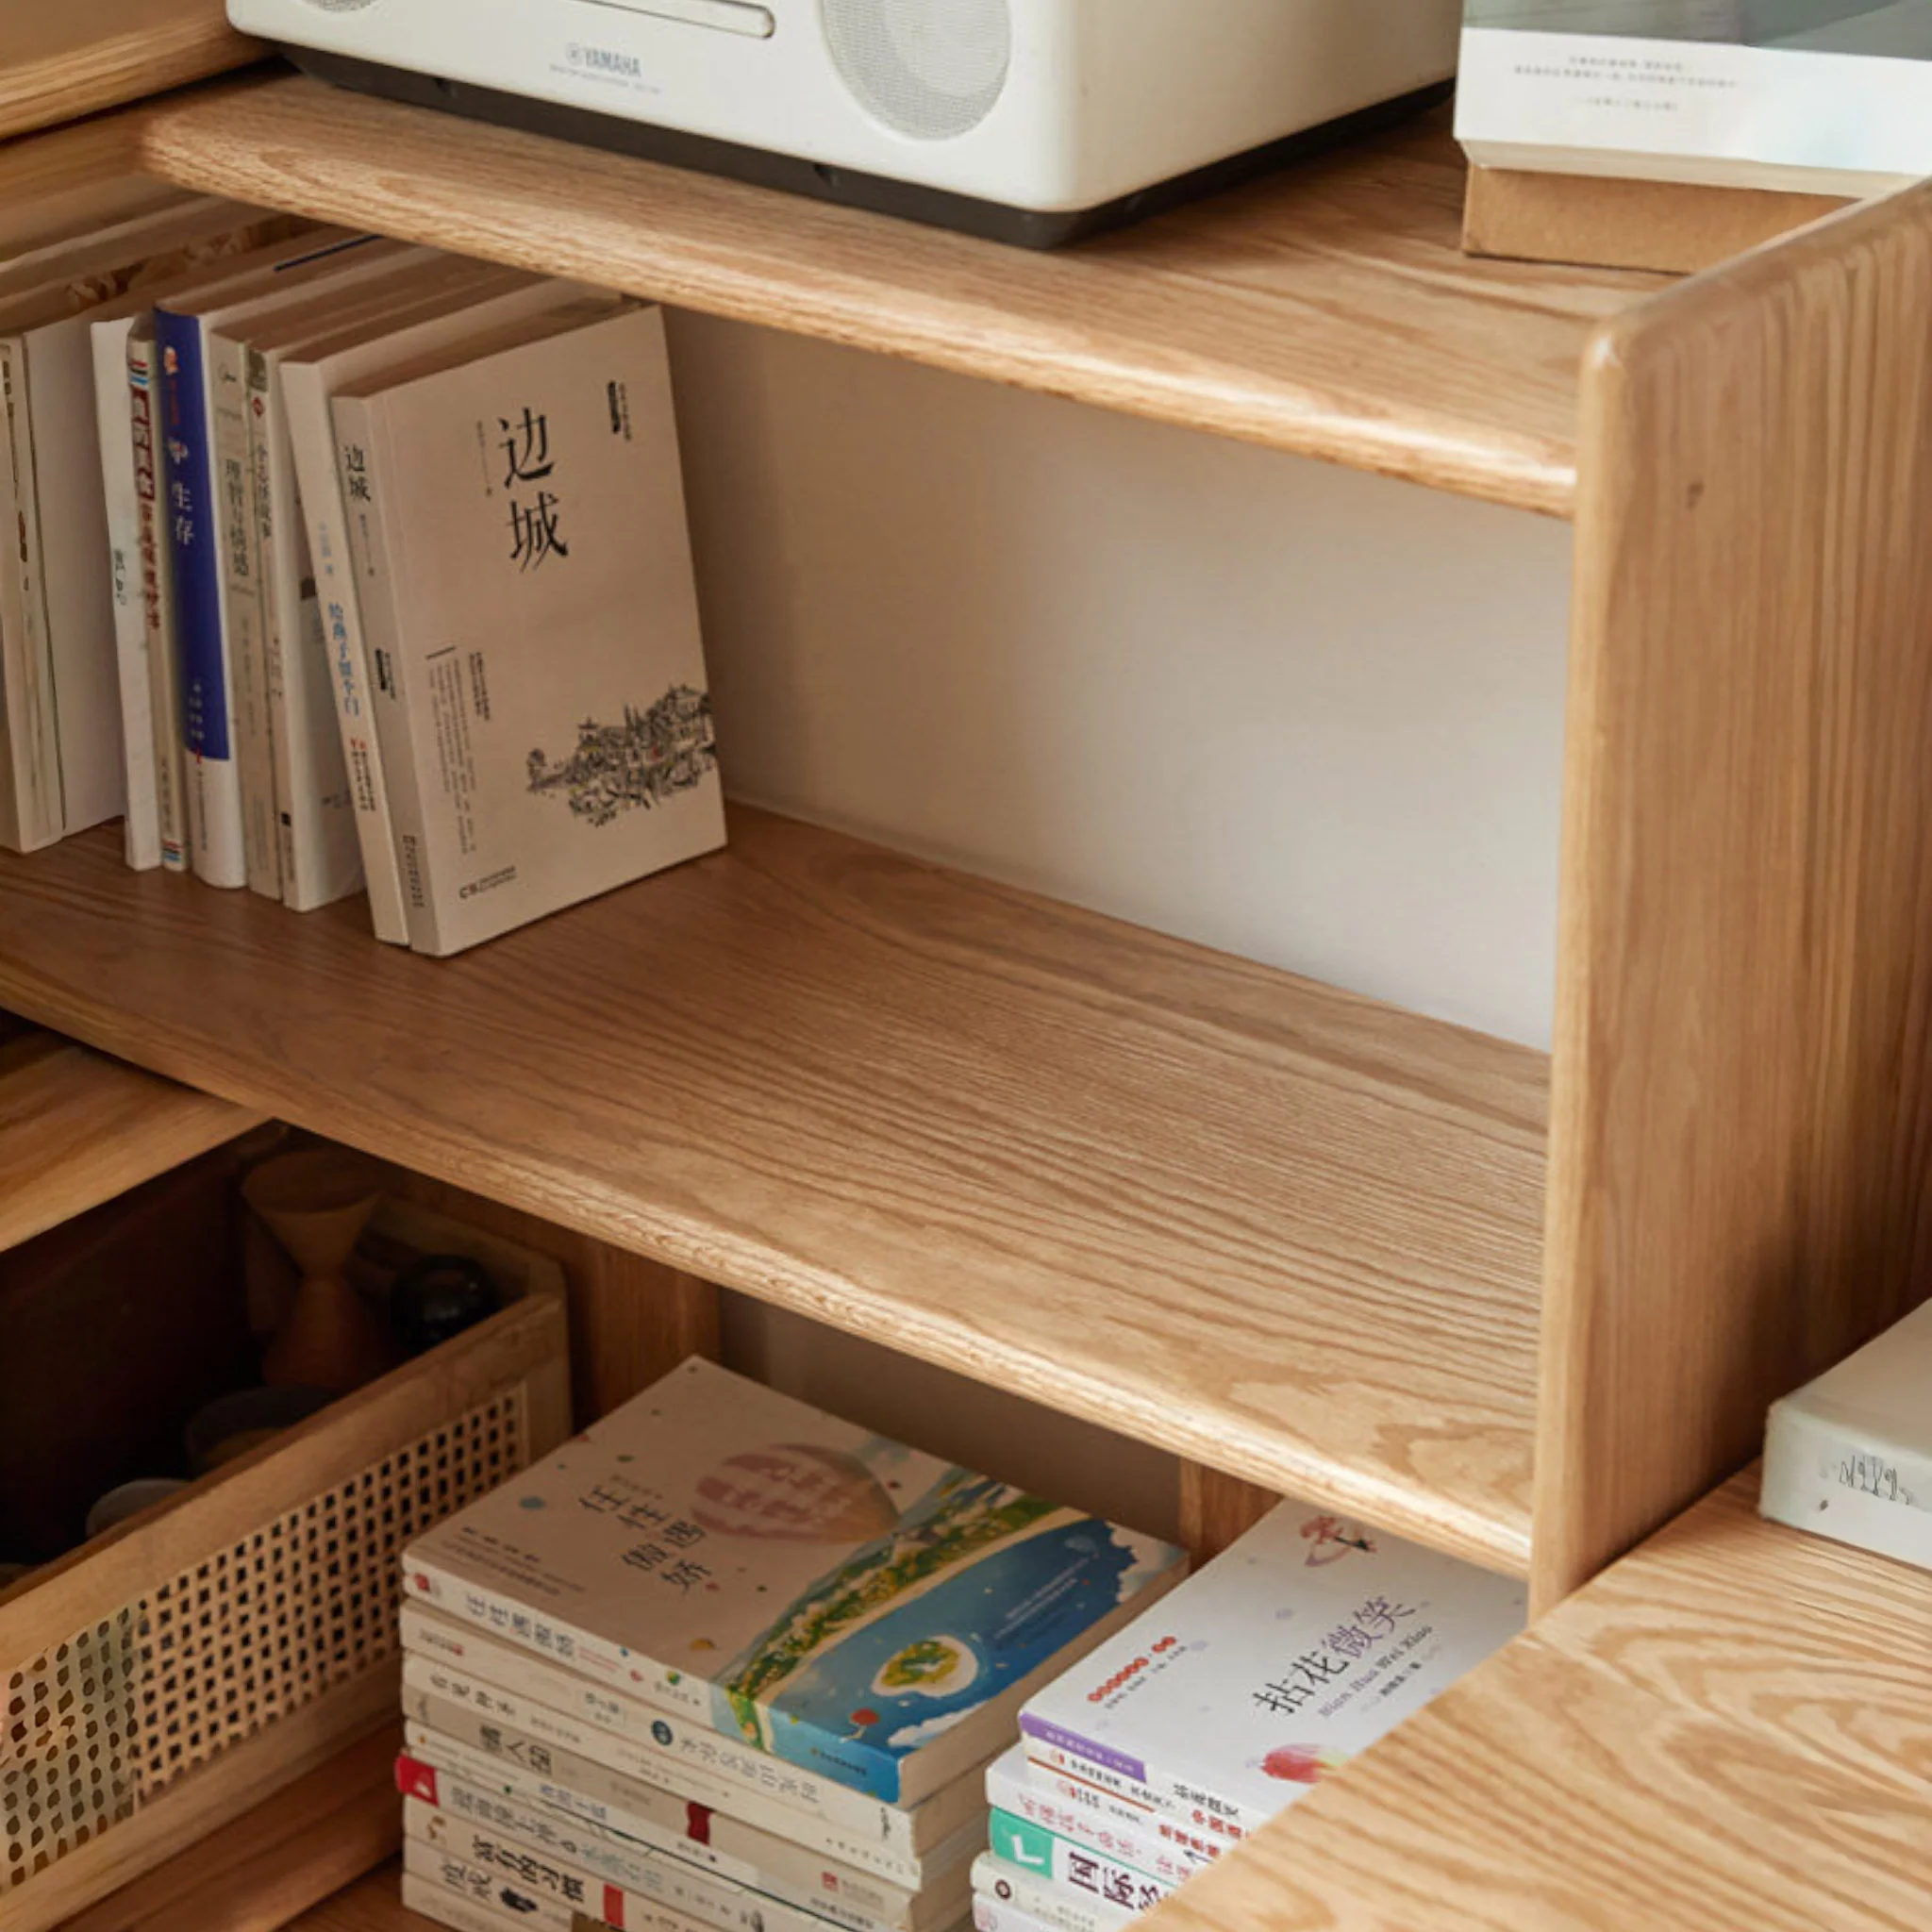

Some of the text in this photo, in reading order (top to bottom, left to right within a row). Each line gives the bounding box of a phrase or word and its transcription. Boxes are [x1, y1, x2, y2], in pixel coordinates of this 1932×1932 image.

[585, 47, 641, 77] YAMAHA
[343, 443, 372, 503] 边城
[497, 407, 569, 574] 边城
[1253, 1595, 1417, 1715] 拈花微笑
